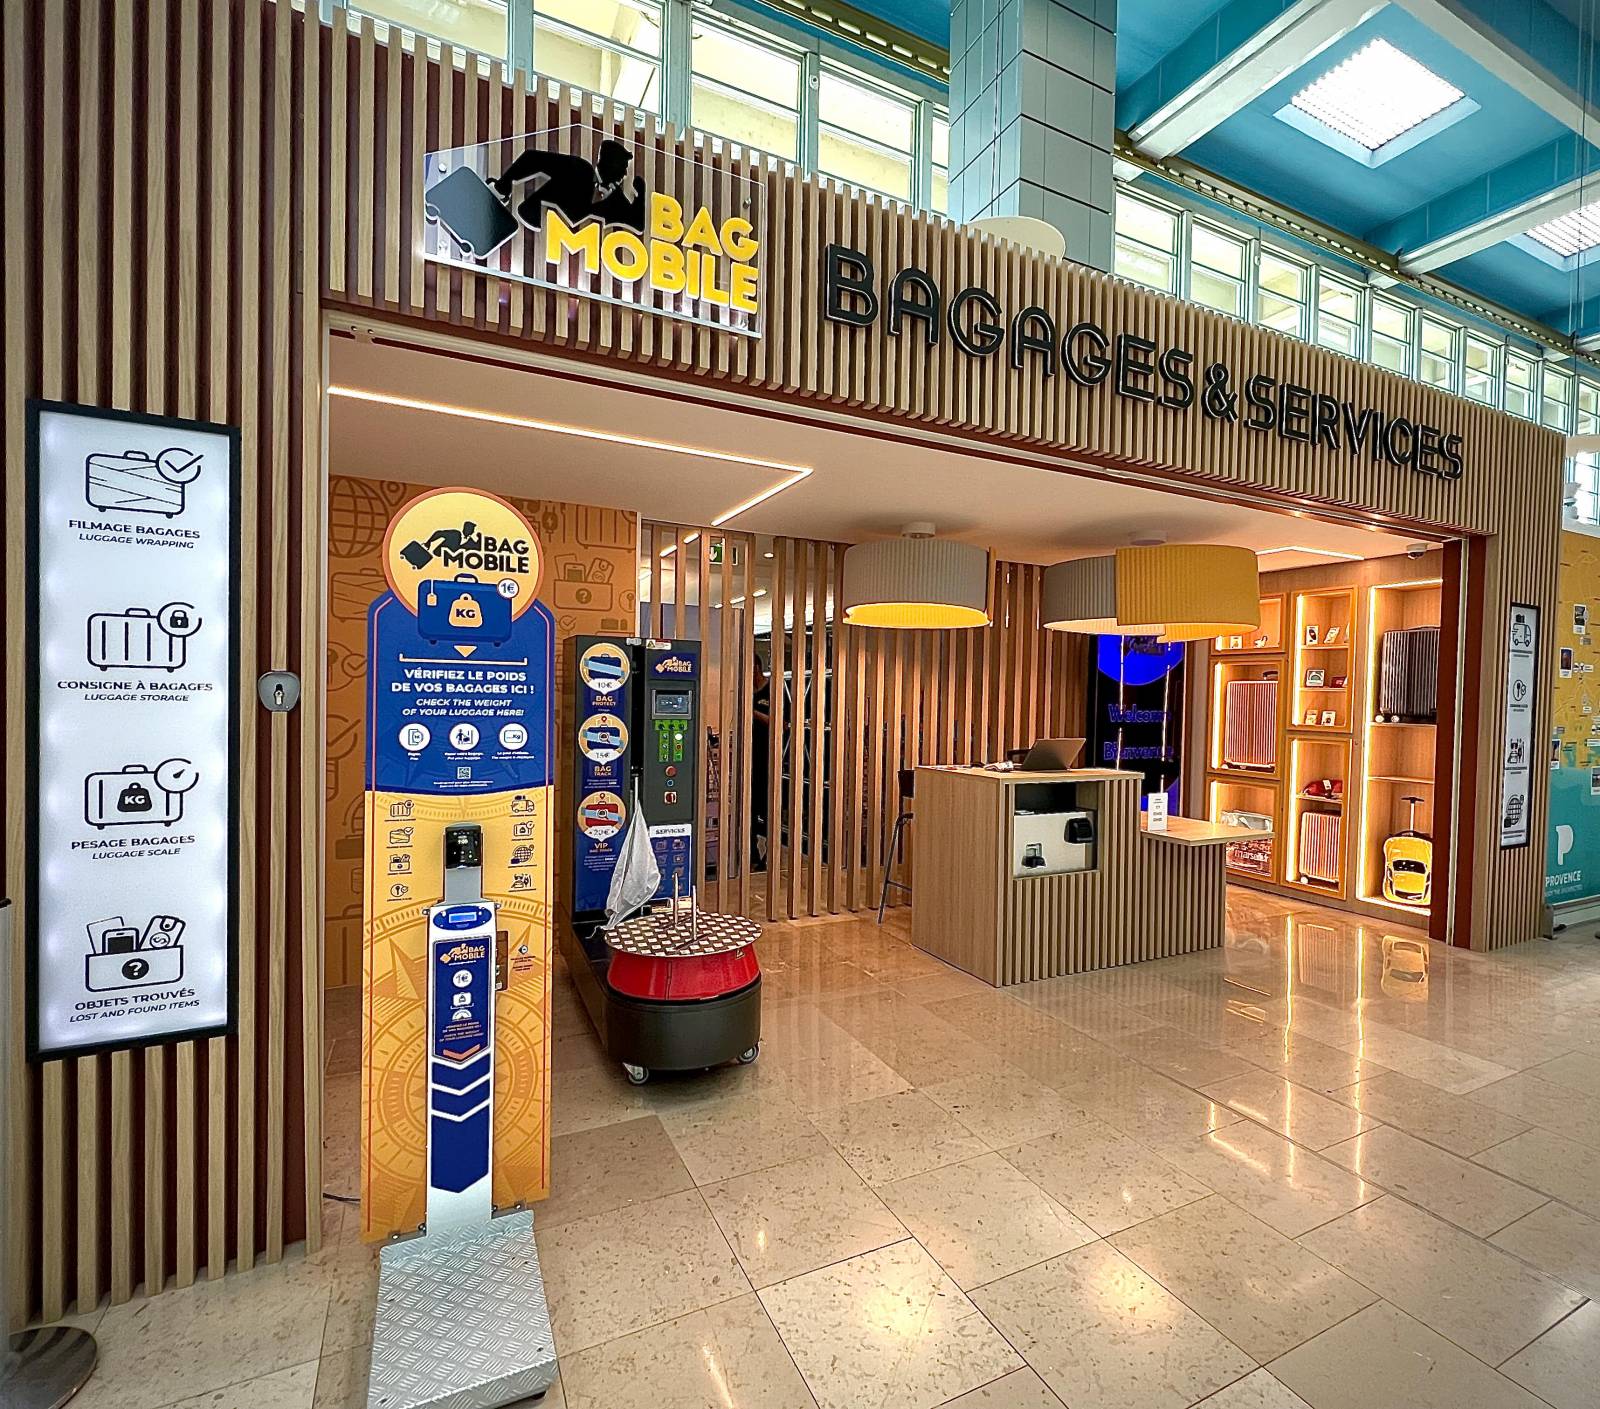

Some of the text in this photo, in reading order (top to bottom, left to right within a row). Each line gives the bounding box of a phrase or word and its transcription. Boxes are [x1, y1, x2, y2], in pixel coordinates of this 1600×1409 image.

[650, 191, 759, 262] BAG
[545, 208, 759, 315] MOBILE
[823, 243, 1464, 480] BAGAGES & SERVICES
[68, 519, 200, 539] FILMAGE BAGAGES
[79, 533, 194, 549] LUGGAGE WRAPPING
[484, 536, 529, 555] BAG
[443, 549, 529, 574] MOBILE
[500, 582, 515, 594] 1€
[455, 608, 476, 618] KG
[404, 667, 527, 682] VÉRIFIEZ LE POIDS
[57, 680, 213, 691] CONSIGNE À BAGAGES
[391, 682, 411, 692] DE
[413, 683, 443, 693] VOS
[445, 683, 508, 694] BAGAGES
[511, 685, 527, 694] ICI
[84, 693, 189, 702] LUGGAGE STORAGE
[416, 698, 512, 707] CHECK THE WEIGHT
[402, 708, 417, 716] OF
[419, 708, 447, 716] YOUR
[124, 795, 145, 805] KG
[71, 835, 195, 850] PESAGE BAGAGES
[92, 847, 181, 860] LUGGAGE SCALE
[1545, 870, 1582, 888] PROVENCE
[454, 950, 485, 961] MOBILE
[469, 945, 485, 953] BAG
[74, 987, 196, 1011] OBJETS TROUVÉS
[69, 1000, 200, 1023] LOST AND FOUND ITEMS
